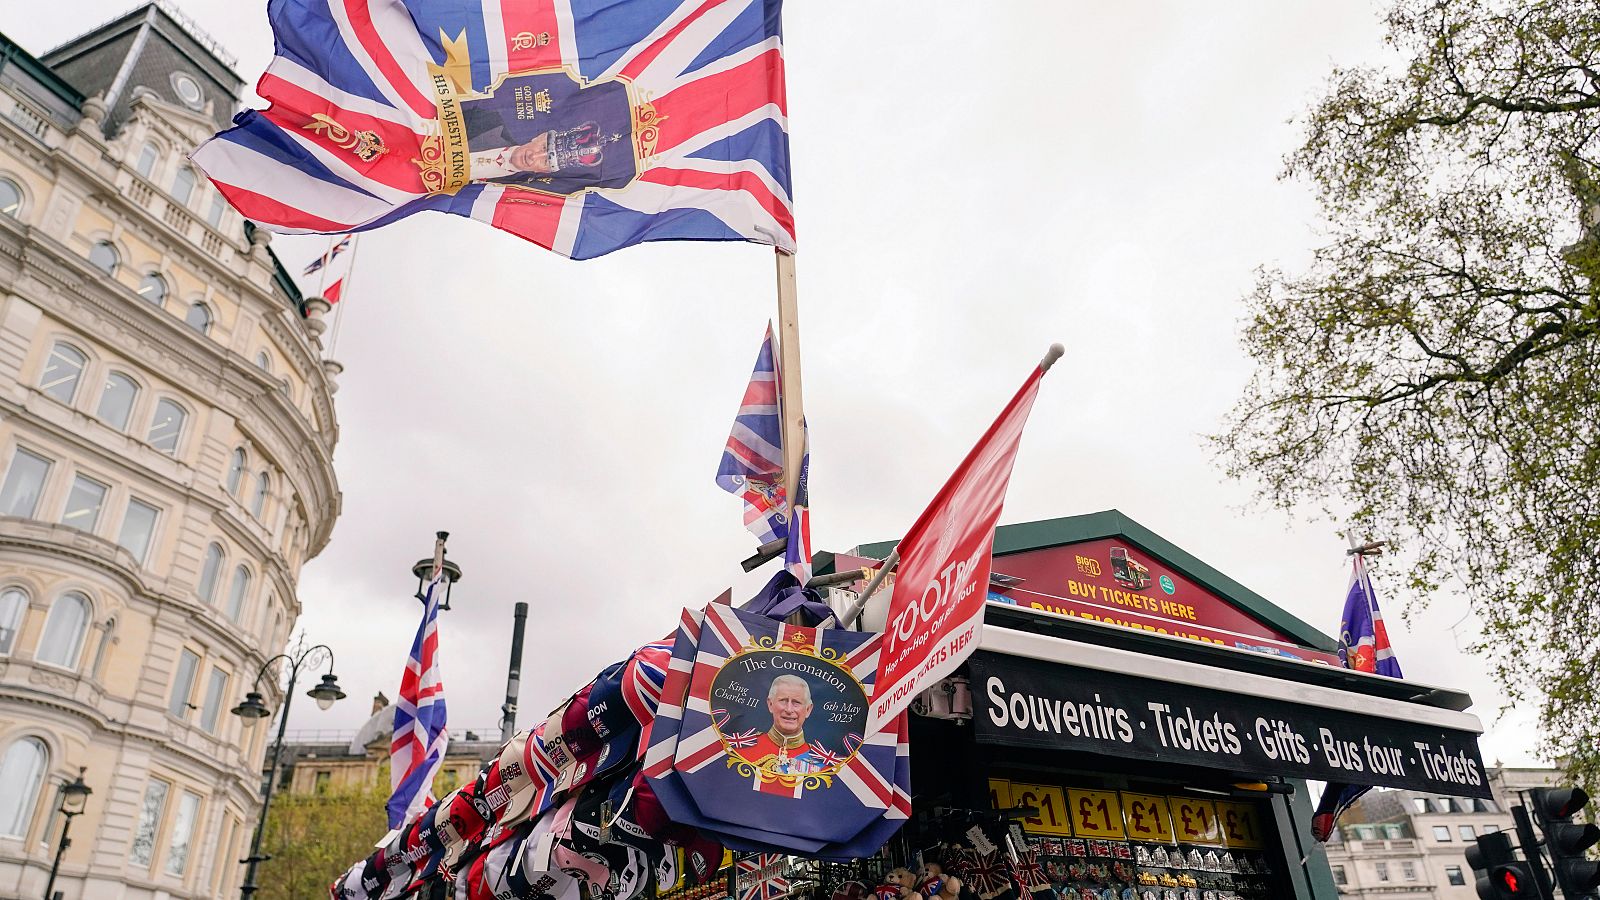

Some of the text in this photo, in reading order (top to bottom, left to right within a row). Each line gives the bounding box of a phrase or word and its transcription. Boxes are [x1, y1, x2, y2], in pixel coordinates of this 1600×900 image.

[433, 74, 449, 95] HIS
[514, 87, 525, 120] THE KING
[523, 86, 535, 120] GOD LOVE
[441, 99, 462, 147] MAJESTY
[451, 151, 464, 178] KING
[1076, 555, 1090, 566] BIG
[1068, 580, 1197, 621] BUY TICKETS HERE
[740, 655, 847, 693] The Coronation
[877, 695, 892, 718] BUY
[893, 677, 916, 704] YOUR
[950, 625, 974, 656] HERE
[885, 658, 898, 677] Hop
[714, 687, 760, 708] Charles III
[728, 680, 750, 696] King
[823, 701, 861, 715] 6th May
[828, 712, 853, 723] 2023
[986, 676, 1481, 786] Souvenirs Tickets Gifts Bus tour Tickets
